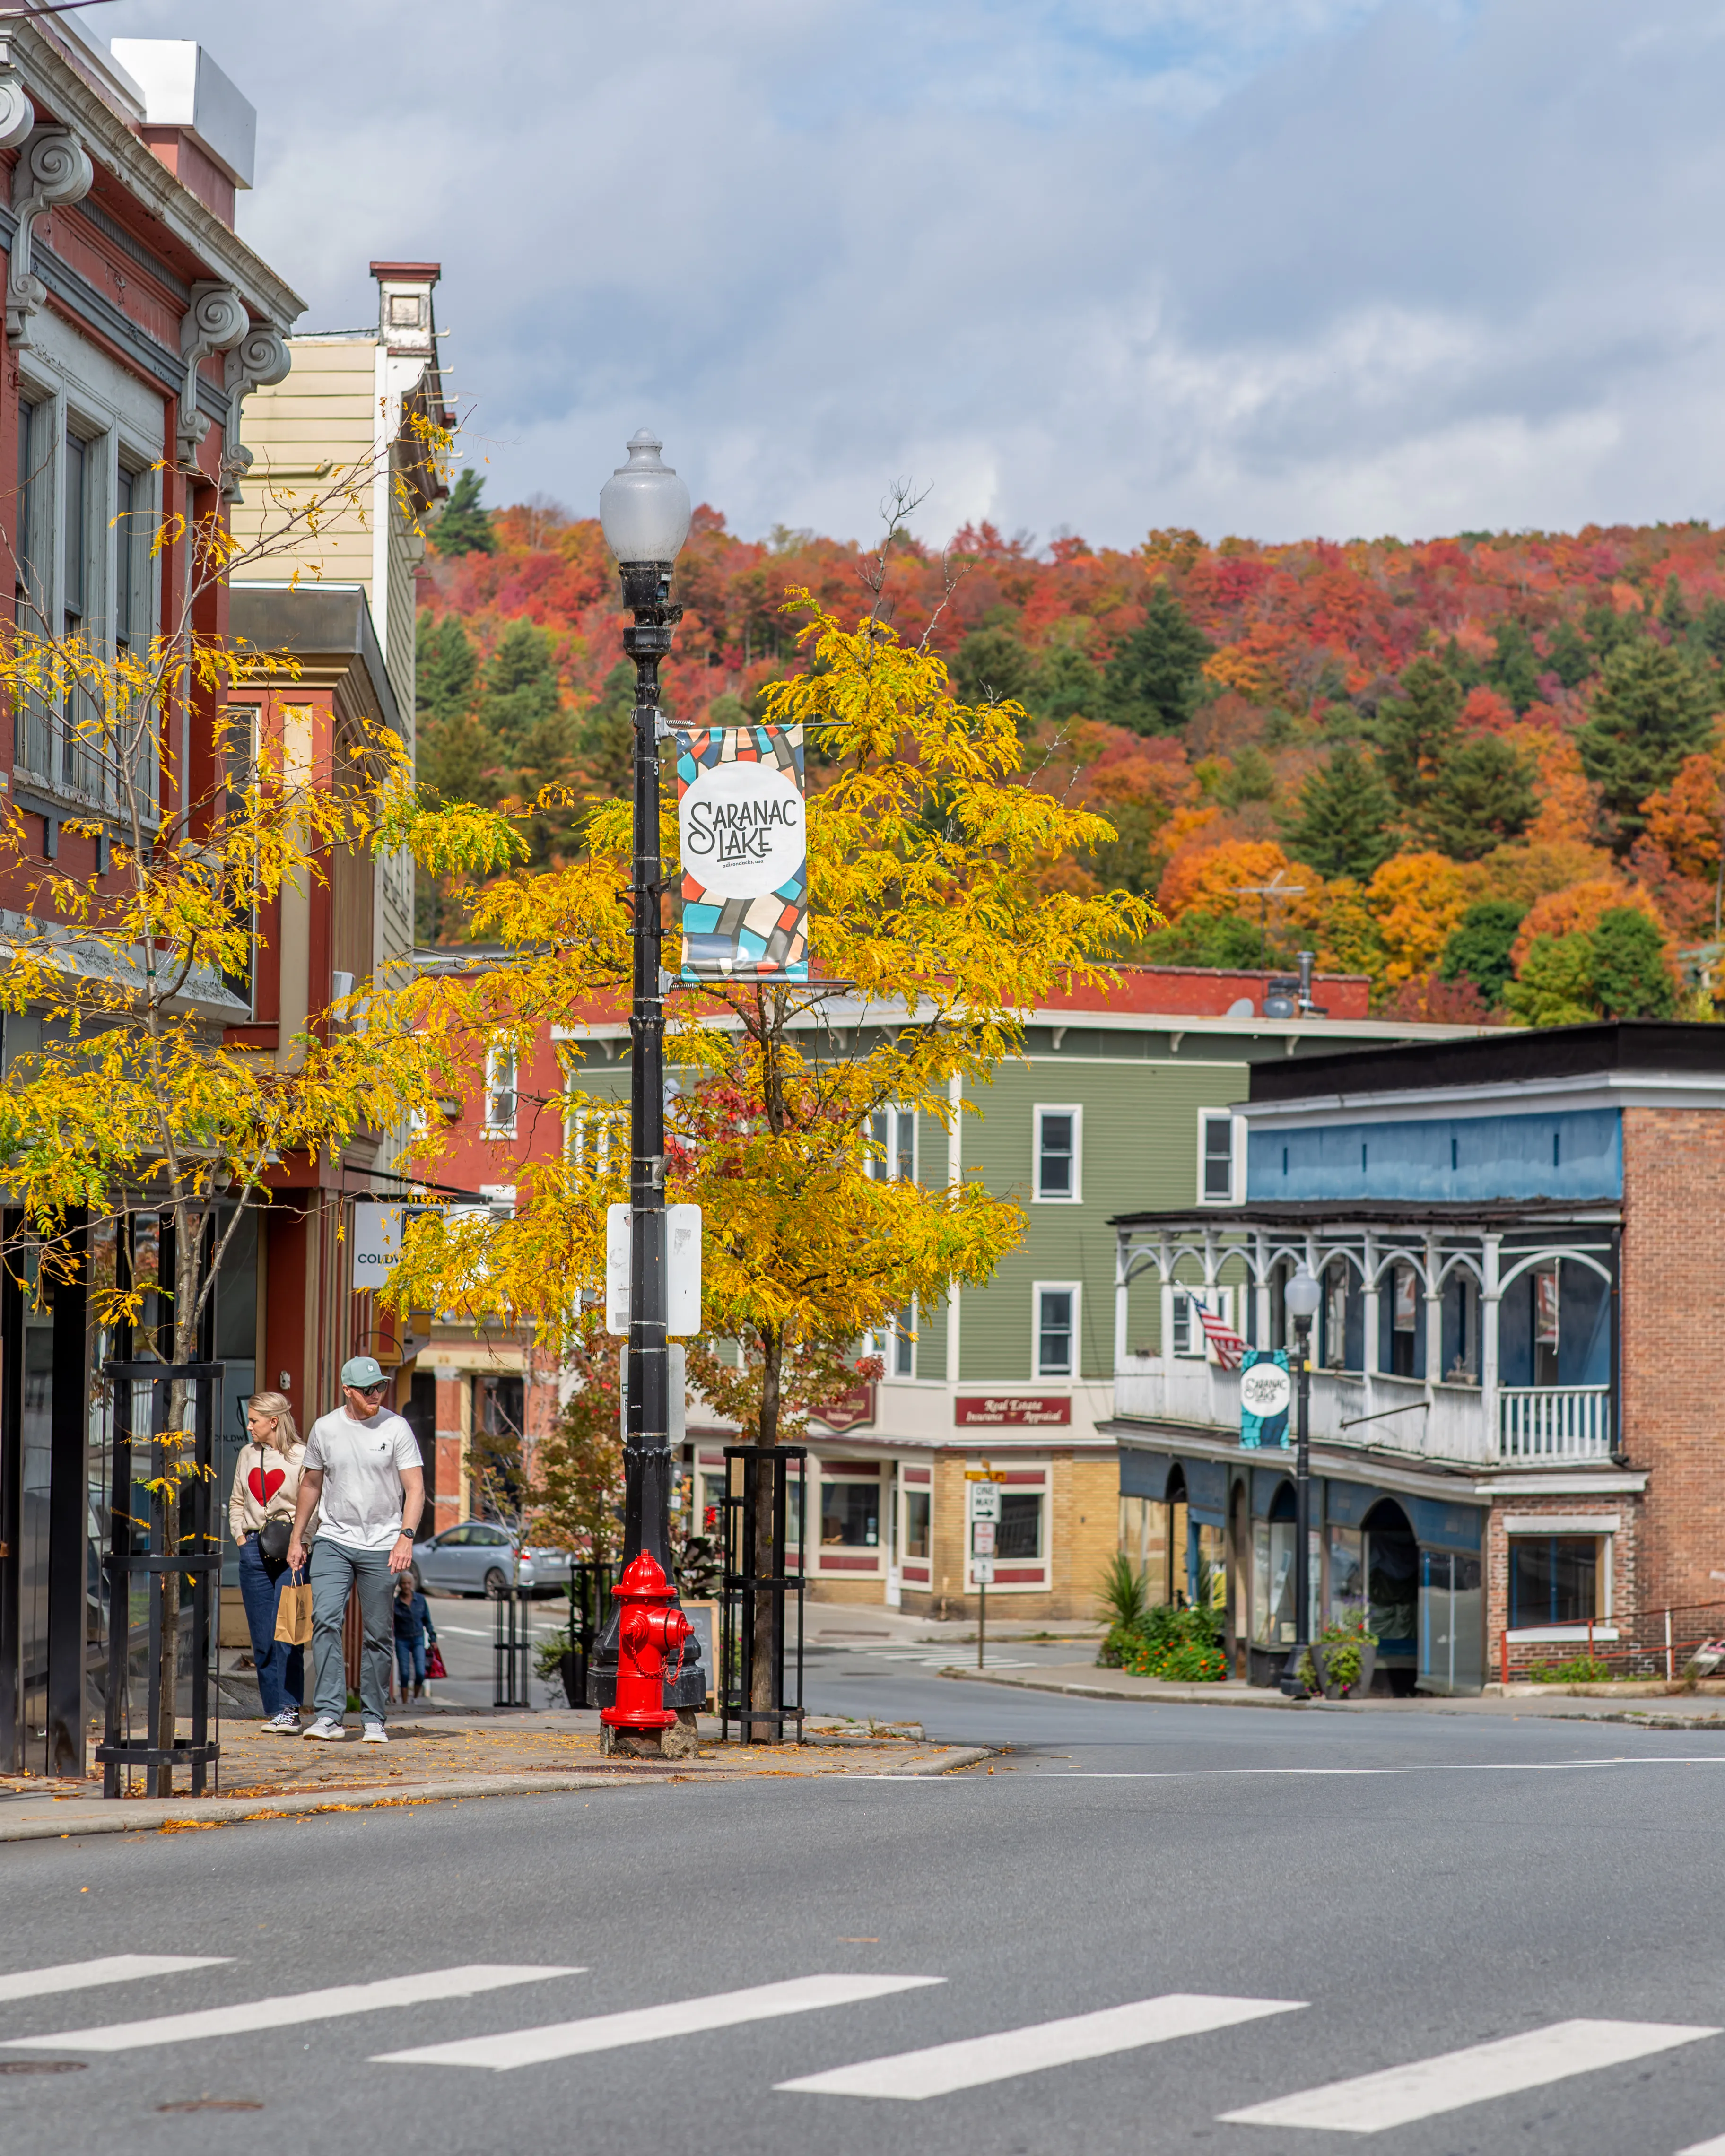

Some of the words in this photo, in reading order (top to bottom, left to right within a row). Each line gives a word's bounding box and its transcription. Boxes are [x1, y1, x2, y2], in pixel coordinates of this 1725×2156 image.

[654, 761, 659, 776] 5
[688, 799, 797, 855] SARANAC
[717, 827, 772, 863] LAKE
[723, 859, 754, 868] adirondacks,
[976, 1486, 995, 1495] ONE
[975, 1497, 995, 1506] WAY
